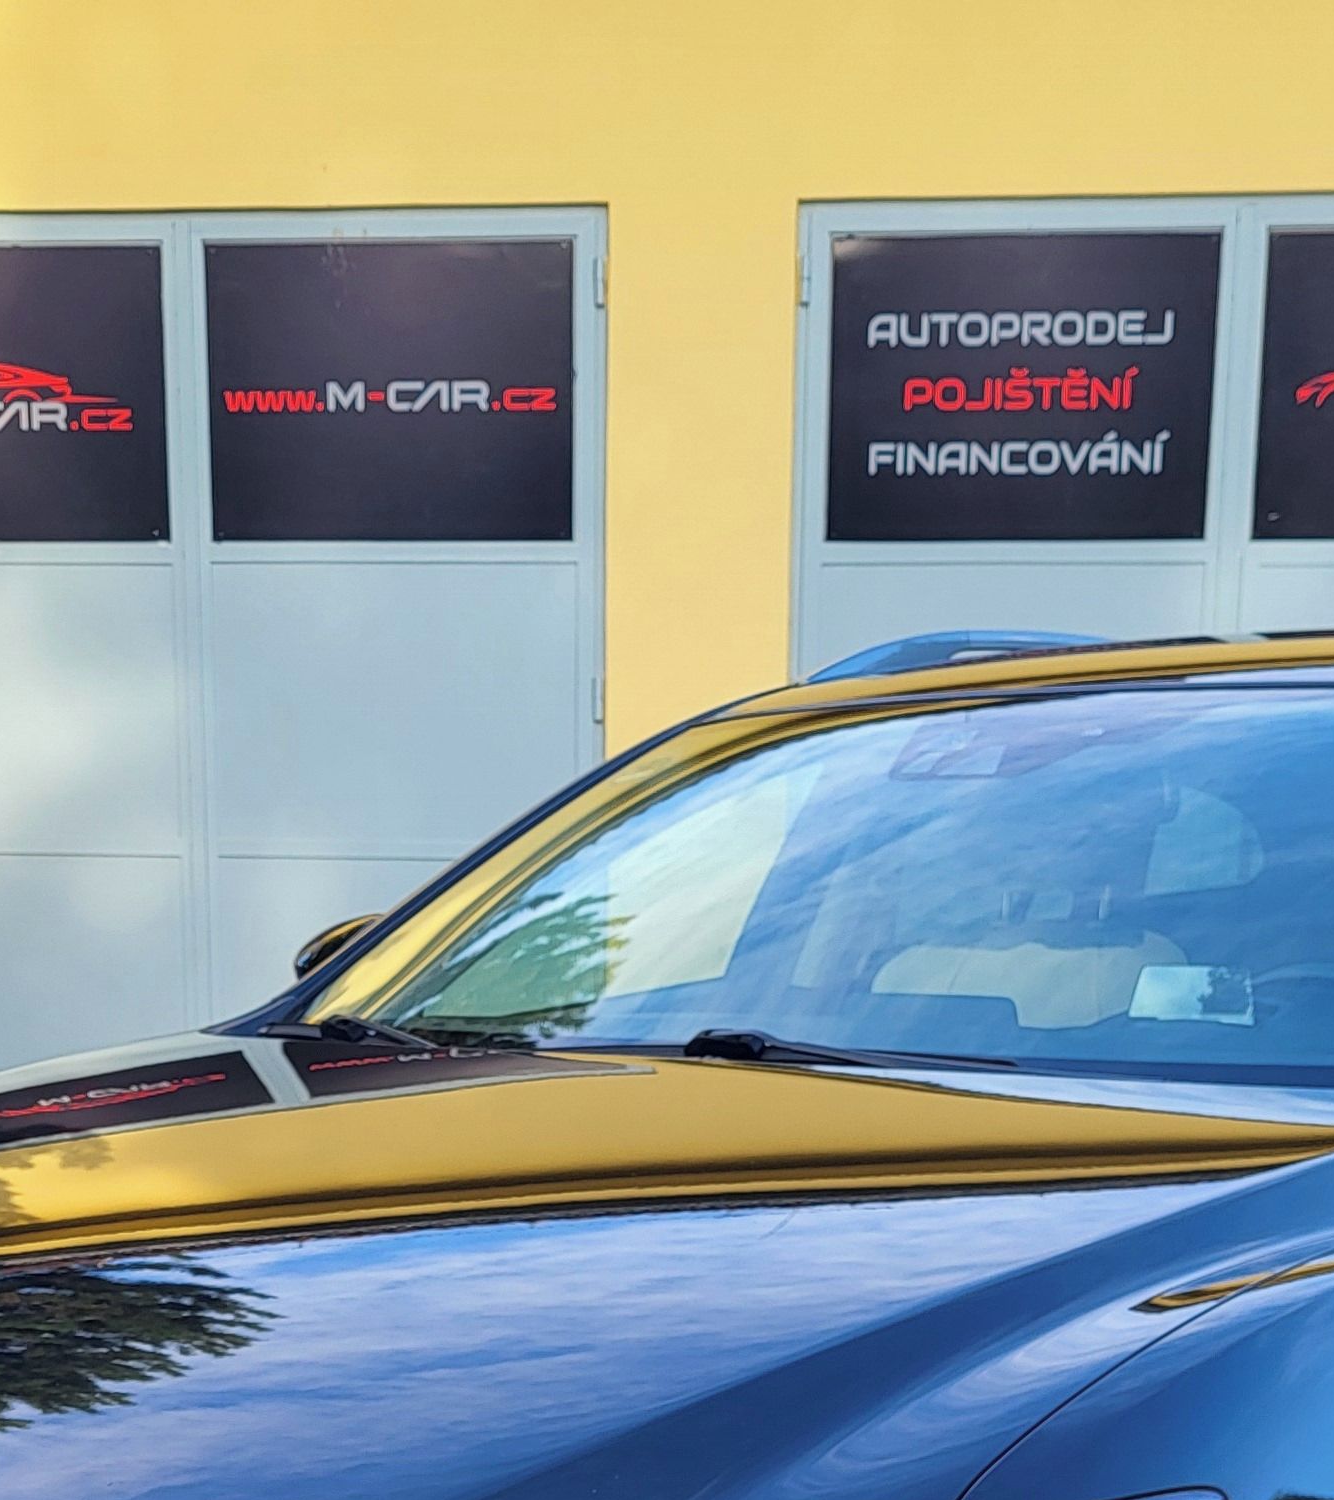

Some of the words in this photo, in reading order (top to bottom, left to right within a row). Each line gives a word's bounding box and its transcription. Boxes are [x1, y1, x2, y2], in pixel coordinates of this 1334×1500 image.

[867, 308, 1175, 348] AUTOPRODEJ
[903, 366, 1140, 412] POJIŠTĚNÍ
[867, 430, 1171, 476] FINANCOVÁNÍ
